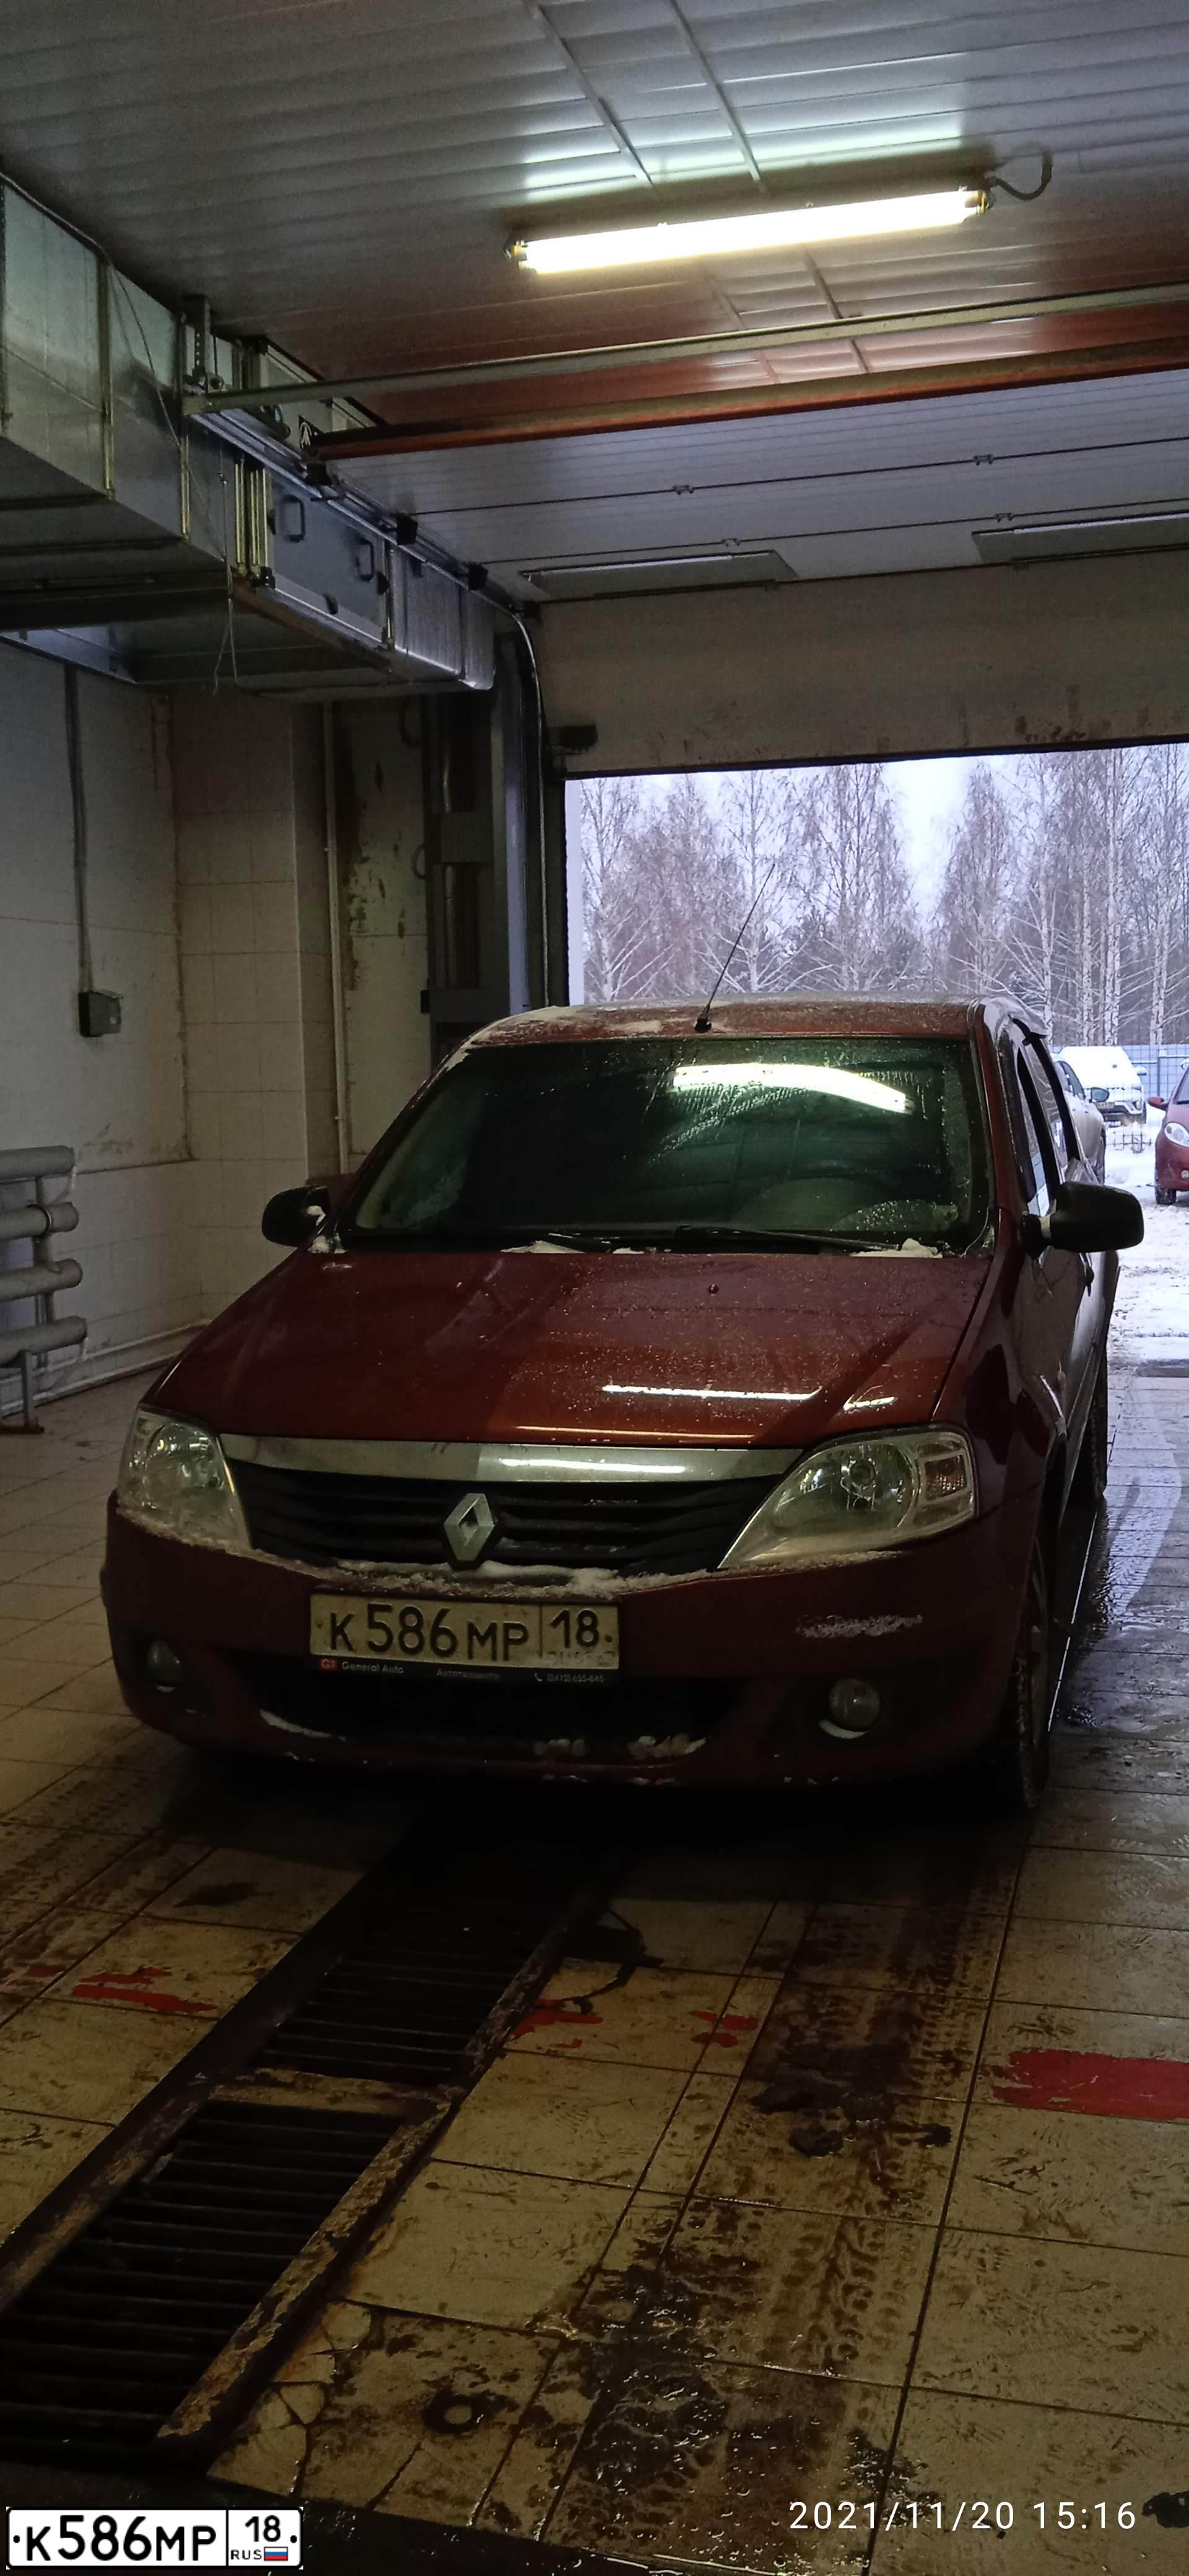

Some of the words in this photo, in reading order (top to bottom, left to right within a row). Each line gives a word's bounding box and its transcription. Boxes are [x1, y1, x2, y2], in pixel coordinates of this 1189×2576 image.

[550, 1609, 599, 1648] 18
[341, 1661, 380, 1672] General
[382, 1664, 404, 1674] Auto
